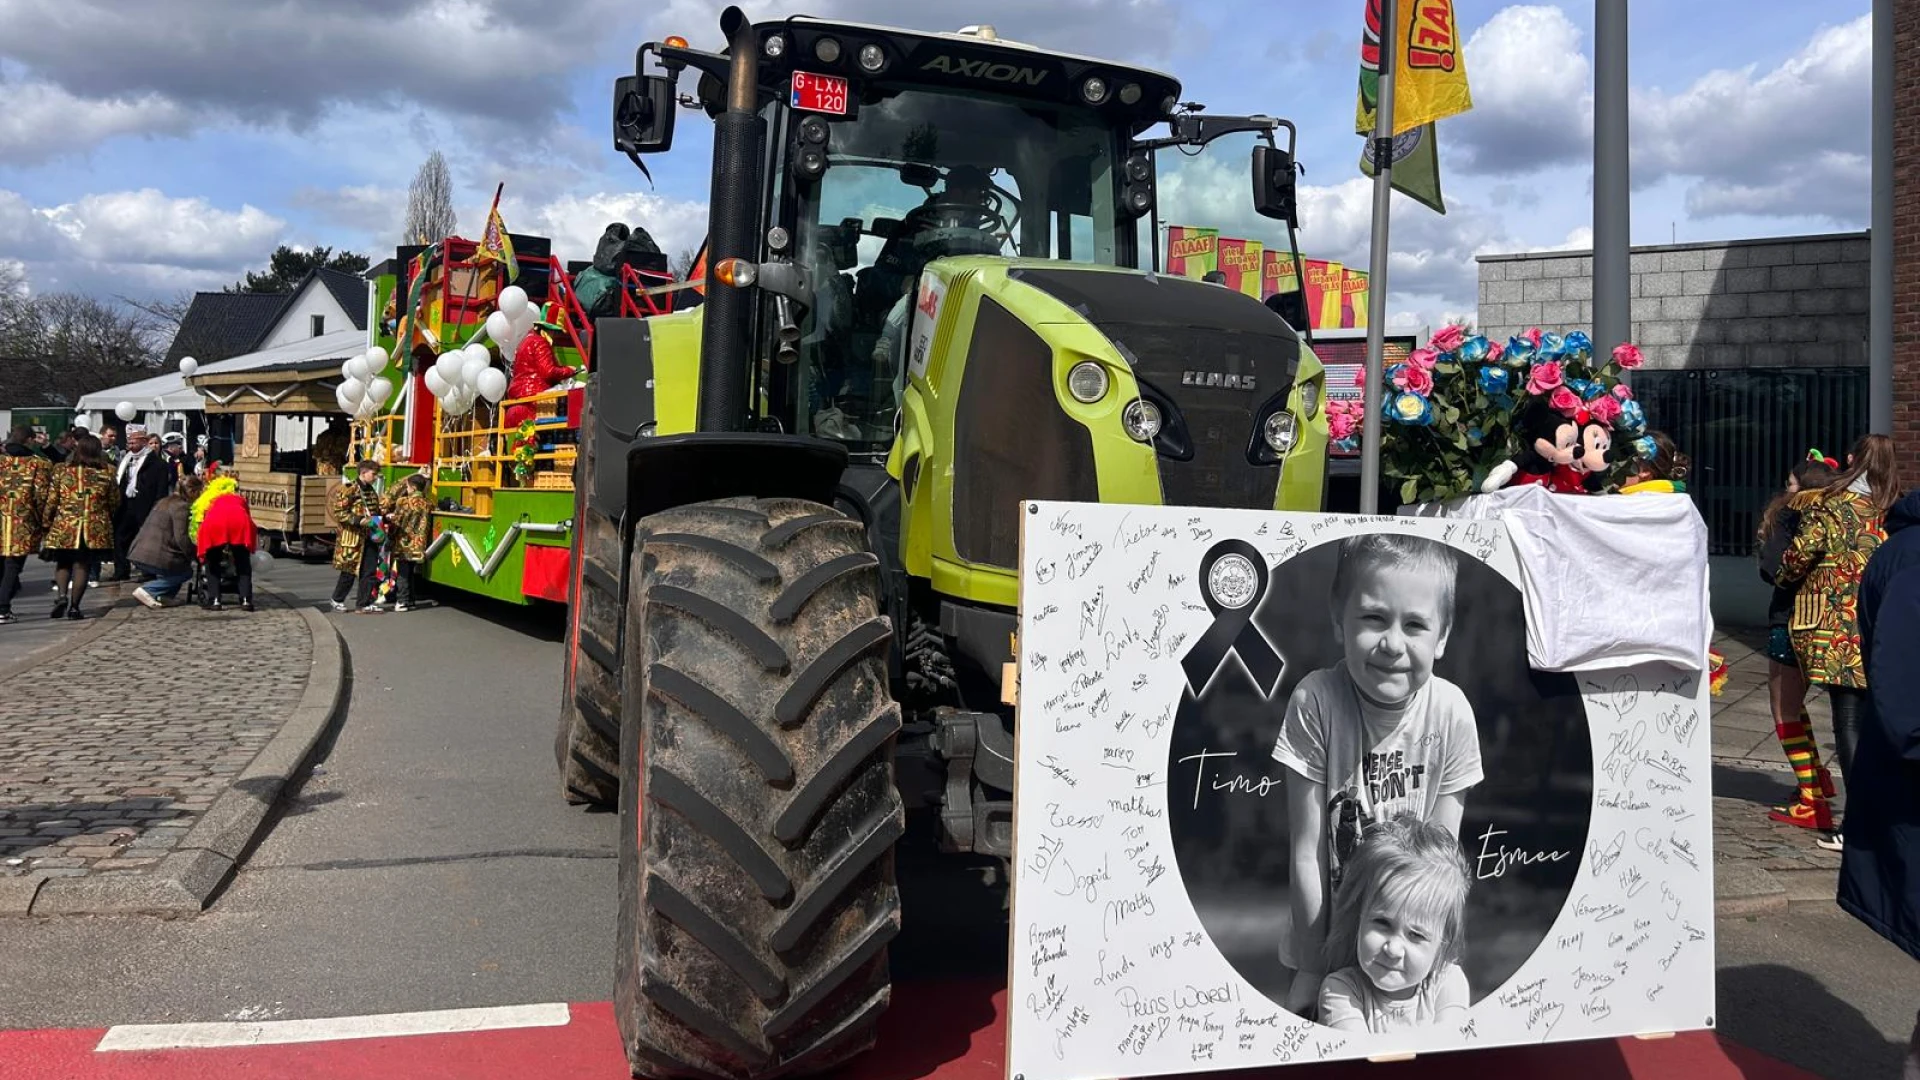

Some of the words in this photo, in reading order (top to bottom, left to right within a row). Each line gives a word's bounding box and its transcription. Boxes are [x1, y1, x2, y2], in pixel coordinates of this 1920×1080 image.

[795, 74, 844, 94] G-LXX
[921, 55, 1049, 85] AXION
[815, 94, 844, 111] 120
[1182, 371, 1256, 390] CLAAS
[1178, 747, 1282, 810] Timo
[1370, 764, 1425, 805] DON'T
[1477, 823, 1571, 879] Esmee
